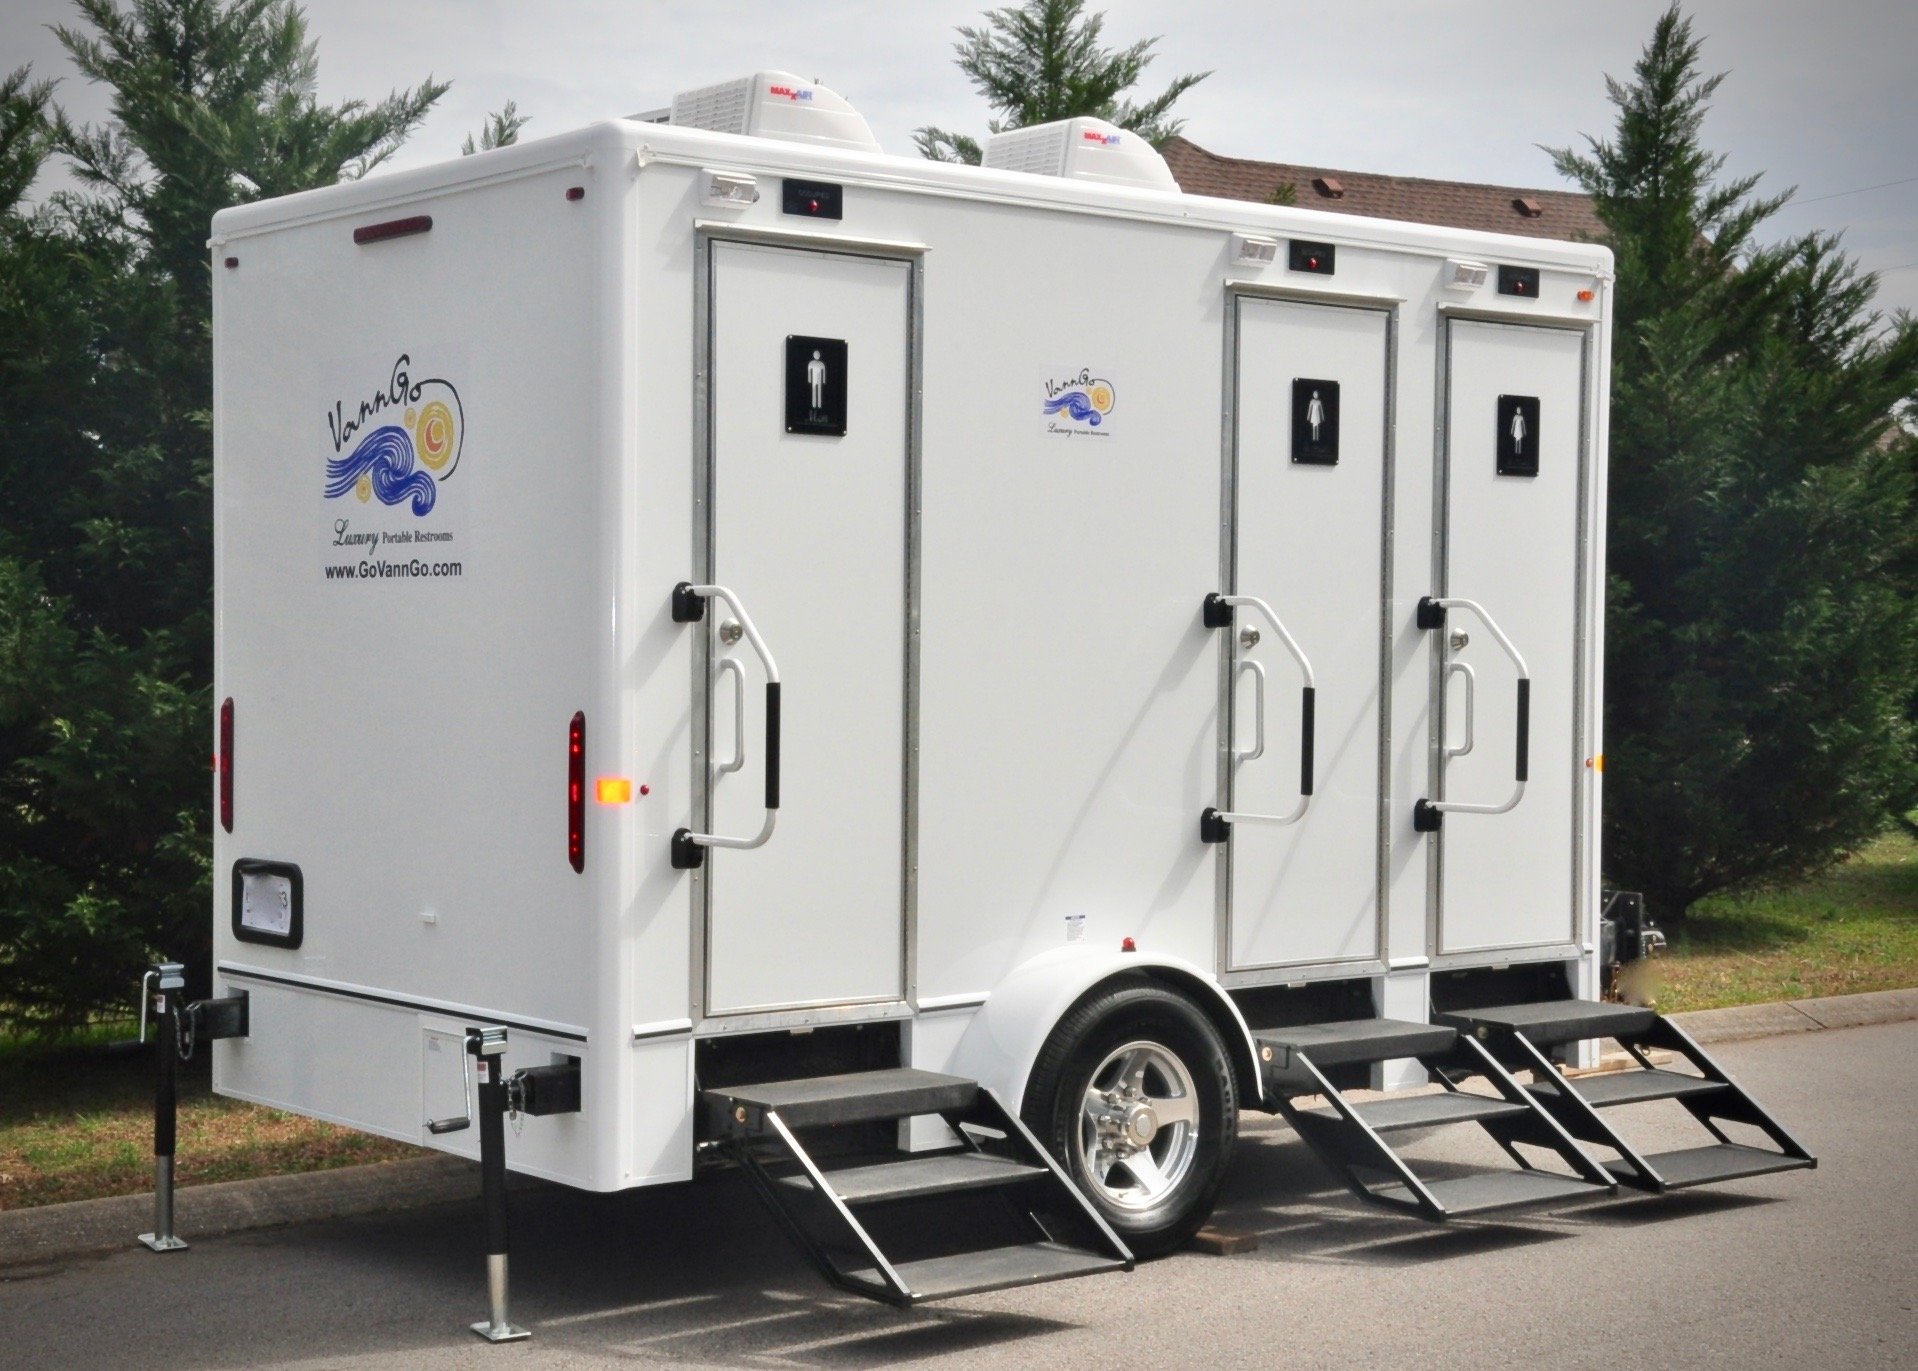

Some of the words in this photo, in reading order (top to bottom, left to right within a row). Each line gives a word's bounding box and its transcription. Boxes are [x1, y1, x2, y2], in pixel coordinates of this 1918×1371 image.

[1045, 367, 1095, 398] VannGo
[328, 353, 422, 452] VannGo
[332, 518, 379, 556] Luxury
[382, 531, 412, 544] Portable
[414, 530, 454, 543] Restrooms
[325, 559, 462, 579] www.GoVannGo.com
